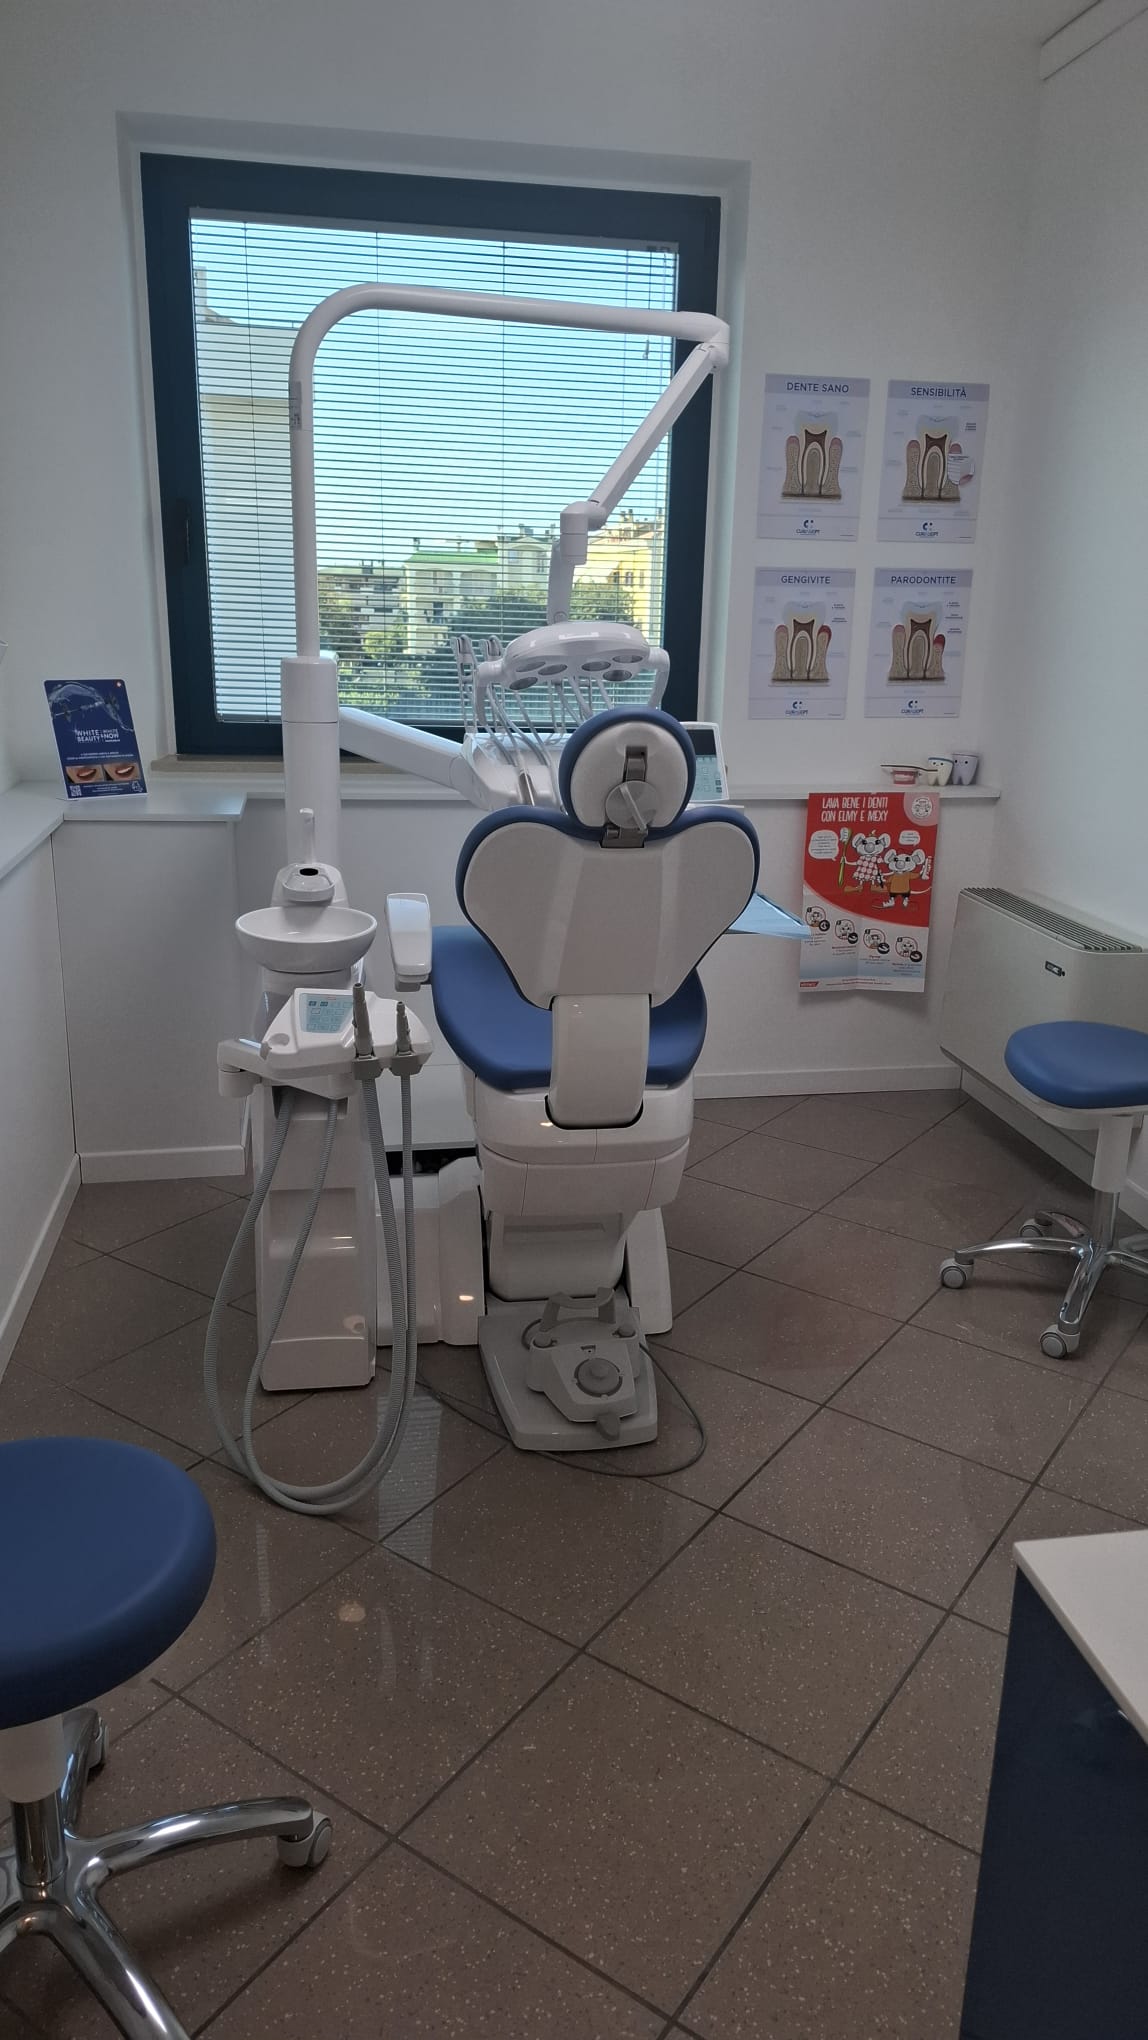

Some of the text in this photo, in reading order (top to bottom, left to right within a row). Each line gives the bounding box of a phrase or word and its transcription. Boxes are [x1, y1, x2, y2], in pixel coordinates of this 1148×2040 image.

[786, 382, 849, 393] DENTE SANO
[911, 386, 967, 398] SENSIBILITÀ
[780, 575, 831, 584] GENGIVITE
[890, 575, 957, 585] PARODONTITE
[822, 796, 889, 809] LAVA BENE I DENTI
[821, 810, 889, 823] CON ELMY E MEXY
